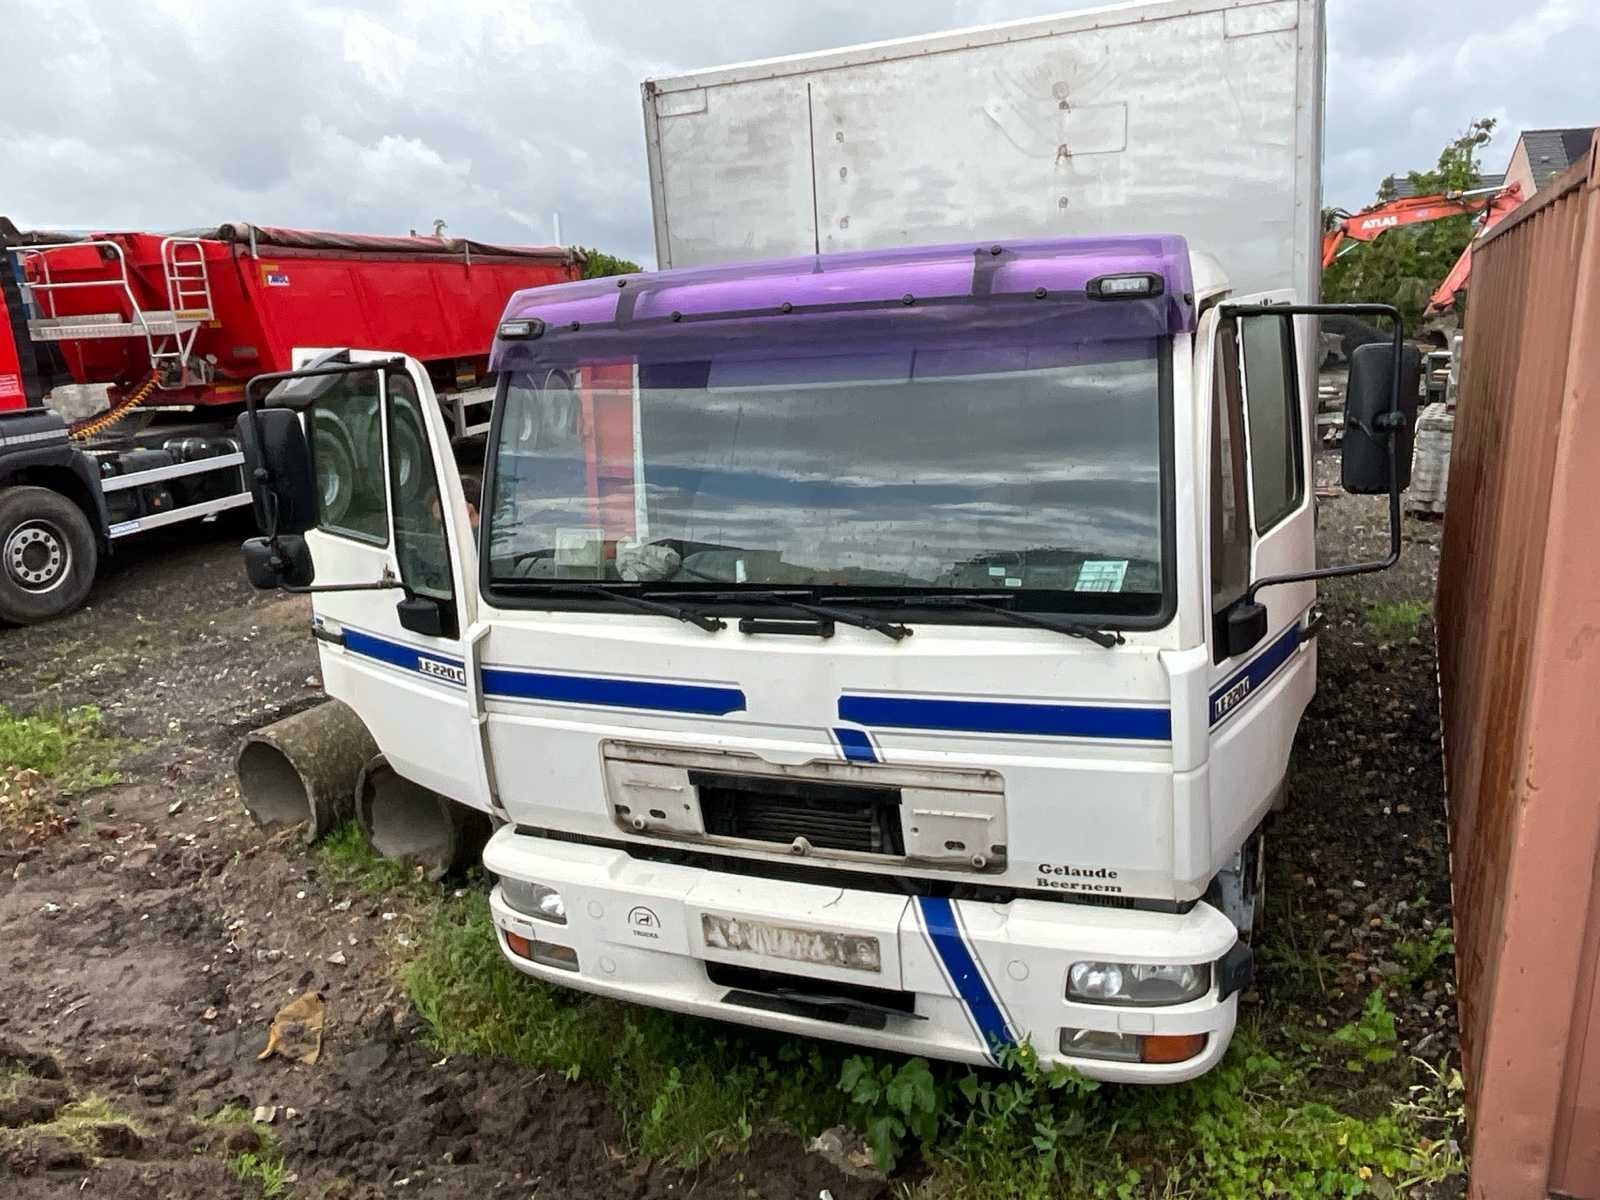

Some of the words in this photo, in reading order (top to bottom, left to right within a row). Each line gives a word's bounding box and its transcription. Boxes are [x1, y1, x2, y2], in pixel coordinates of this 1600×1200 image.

[1361, 215, 1398, 229] ATLAS
[1038, 863, 1118, 879] Gelaude
[1037, 878, 1122, 893] Beernem
